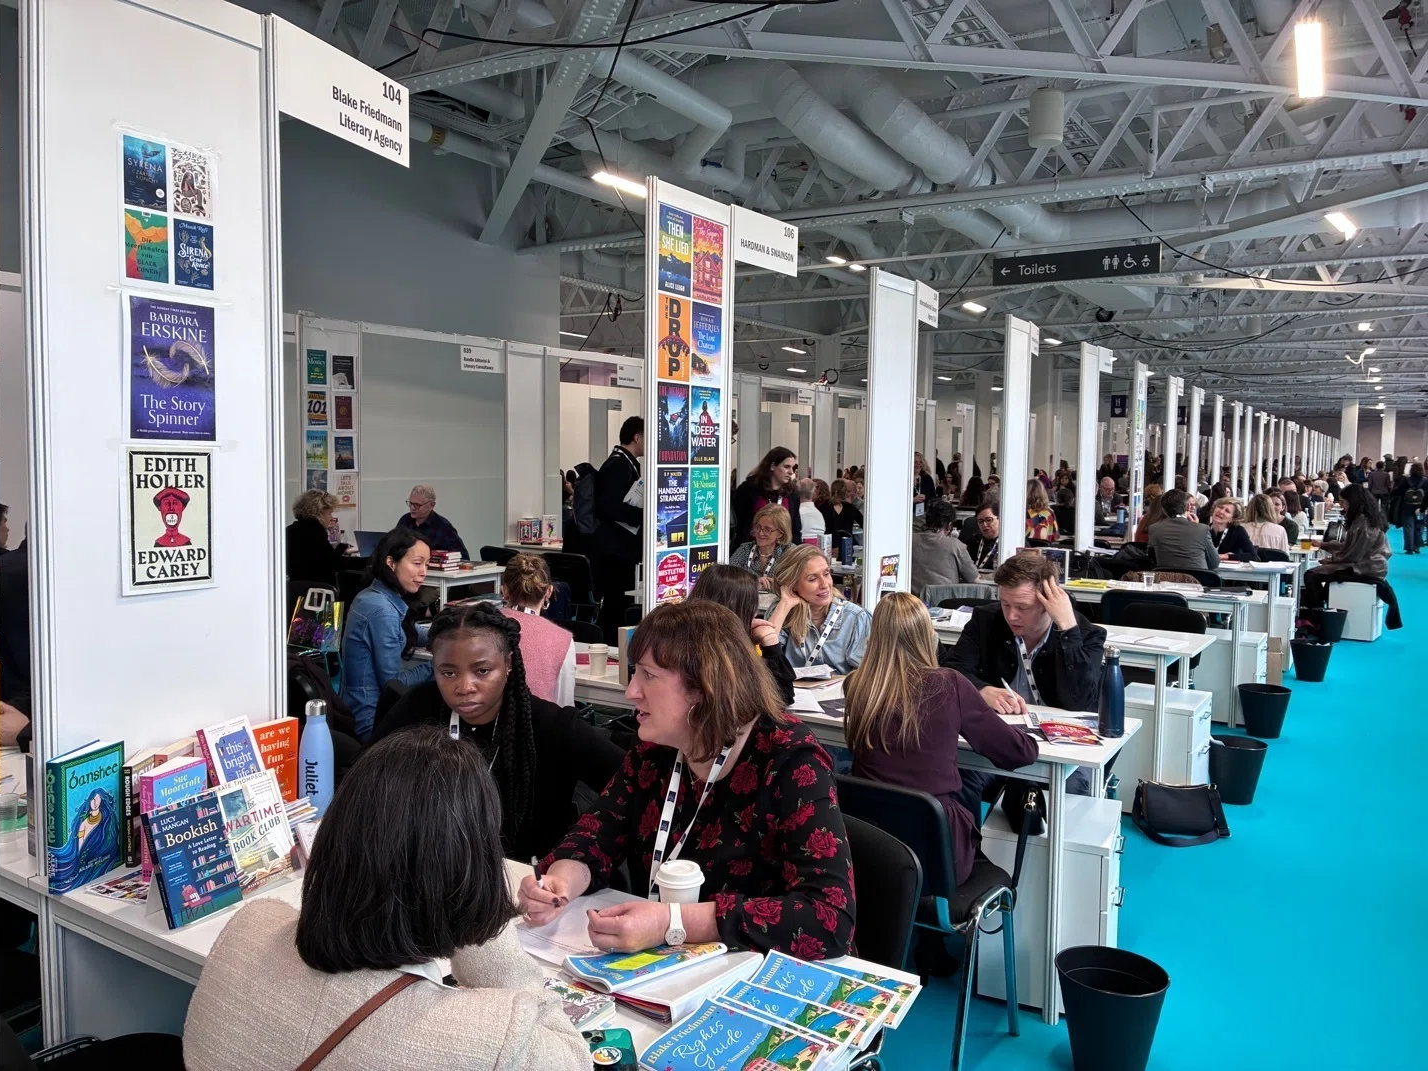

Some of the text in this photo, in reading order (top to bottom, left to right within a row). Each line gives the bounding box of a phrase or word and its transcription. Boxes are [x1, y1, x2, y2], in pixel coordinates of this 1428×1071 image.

[382, 81, 402, 106] 104
[332, 85, 402, 132] Blake Friedmann
[340, 112, 402, 156] Literary Agency
[128, 157, 163, 173] SYRENA
[667, 220, 684, 238] THEN
[784, 226, 795, 239] 106
[142, 236, 152, 244] Die
[661, 235, 689, 256] SHE LIED
[740, 238, 794, 262] HARDMAN & SWAINSON
[136, 266, 158, 275] CONCH
[137, 258, 158, 268] BLACK
[1018, 263, 1057, 276] Toilets
[149, 311, 199, 328] BARBARA
[693, 320, 720, 333] JEFFERIES
[141, 321, 208, 344] ERSKINE
[668, 297, 682, 376] DROP
[698, 331, 715, 342] The Lost
[140, 394, 206, 416] The Story
[307, 400, 327, 414] 101
[148, 410, 199, 428] Spinner
[700, 415, 708, 424] IN
[695, 426, 715, 436] DEEP
[692, 437, 717, 447] WATER
[144, 457, 197, 472] EDITH
[136, 474, 205, 489] HOLLER
[659, 494, 686, 502] STRANGER
[706, 490, 715, 501] Me
[695, 502, 702, 514] To
[703, 501, 713, 515] You
[138, 548, 206, 565] EDWARD
[698, 550, 710, 560] THE
[146, 562, 200, 579] CAREY
[259, 726, 291, 741] are we
[226, 743, 244, 756] this
[261, 737, 290, 754] having
[224, 751, 252, 770] bright
[267, 754, 284, 765] fun
[68, 762, 119, 790] banshee
[173, 772, 188, 785] Sue
[235, 767, 250, 779] life
[305, 759, 319, 796] Juliet
[160, 775, 201, 798] Moorcroft
[218, 771, 268, 792] KATE THOMPSON
[160, 816, 176, 826] LUCY
[224, 802, 282, 833] WARTIME
[162, 818, 189, 833] MANGAN
[164, 818, 218, 848] Bookish
[232, 815, 281, 853] BOOK CLUB
[193, 840, 204, 849] Love
[204, 835, 218, 846] Letter
[198, 842, 217, 854] Reading
[647, 1005, 717, 1064] Blake Friedmann
[672, 1020, 724, 1059] Rights
[749, 1032, 762, 1046] 2026
[694, 1029, 742, 1070] Guide
